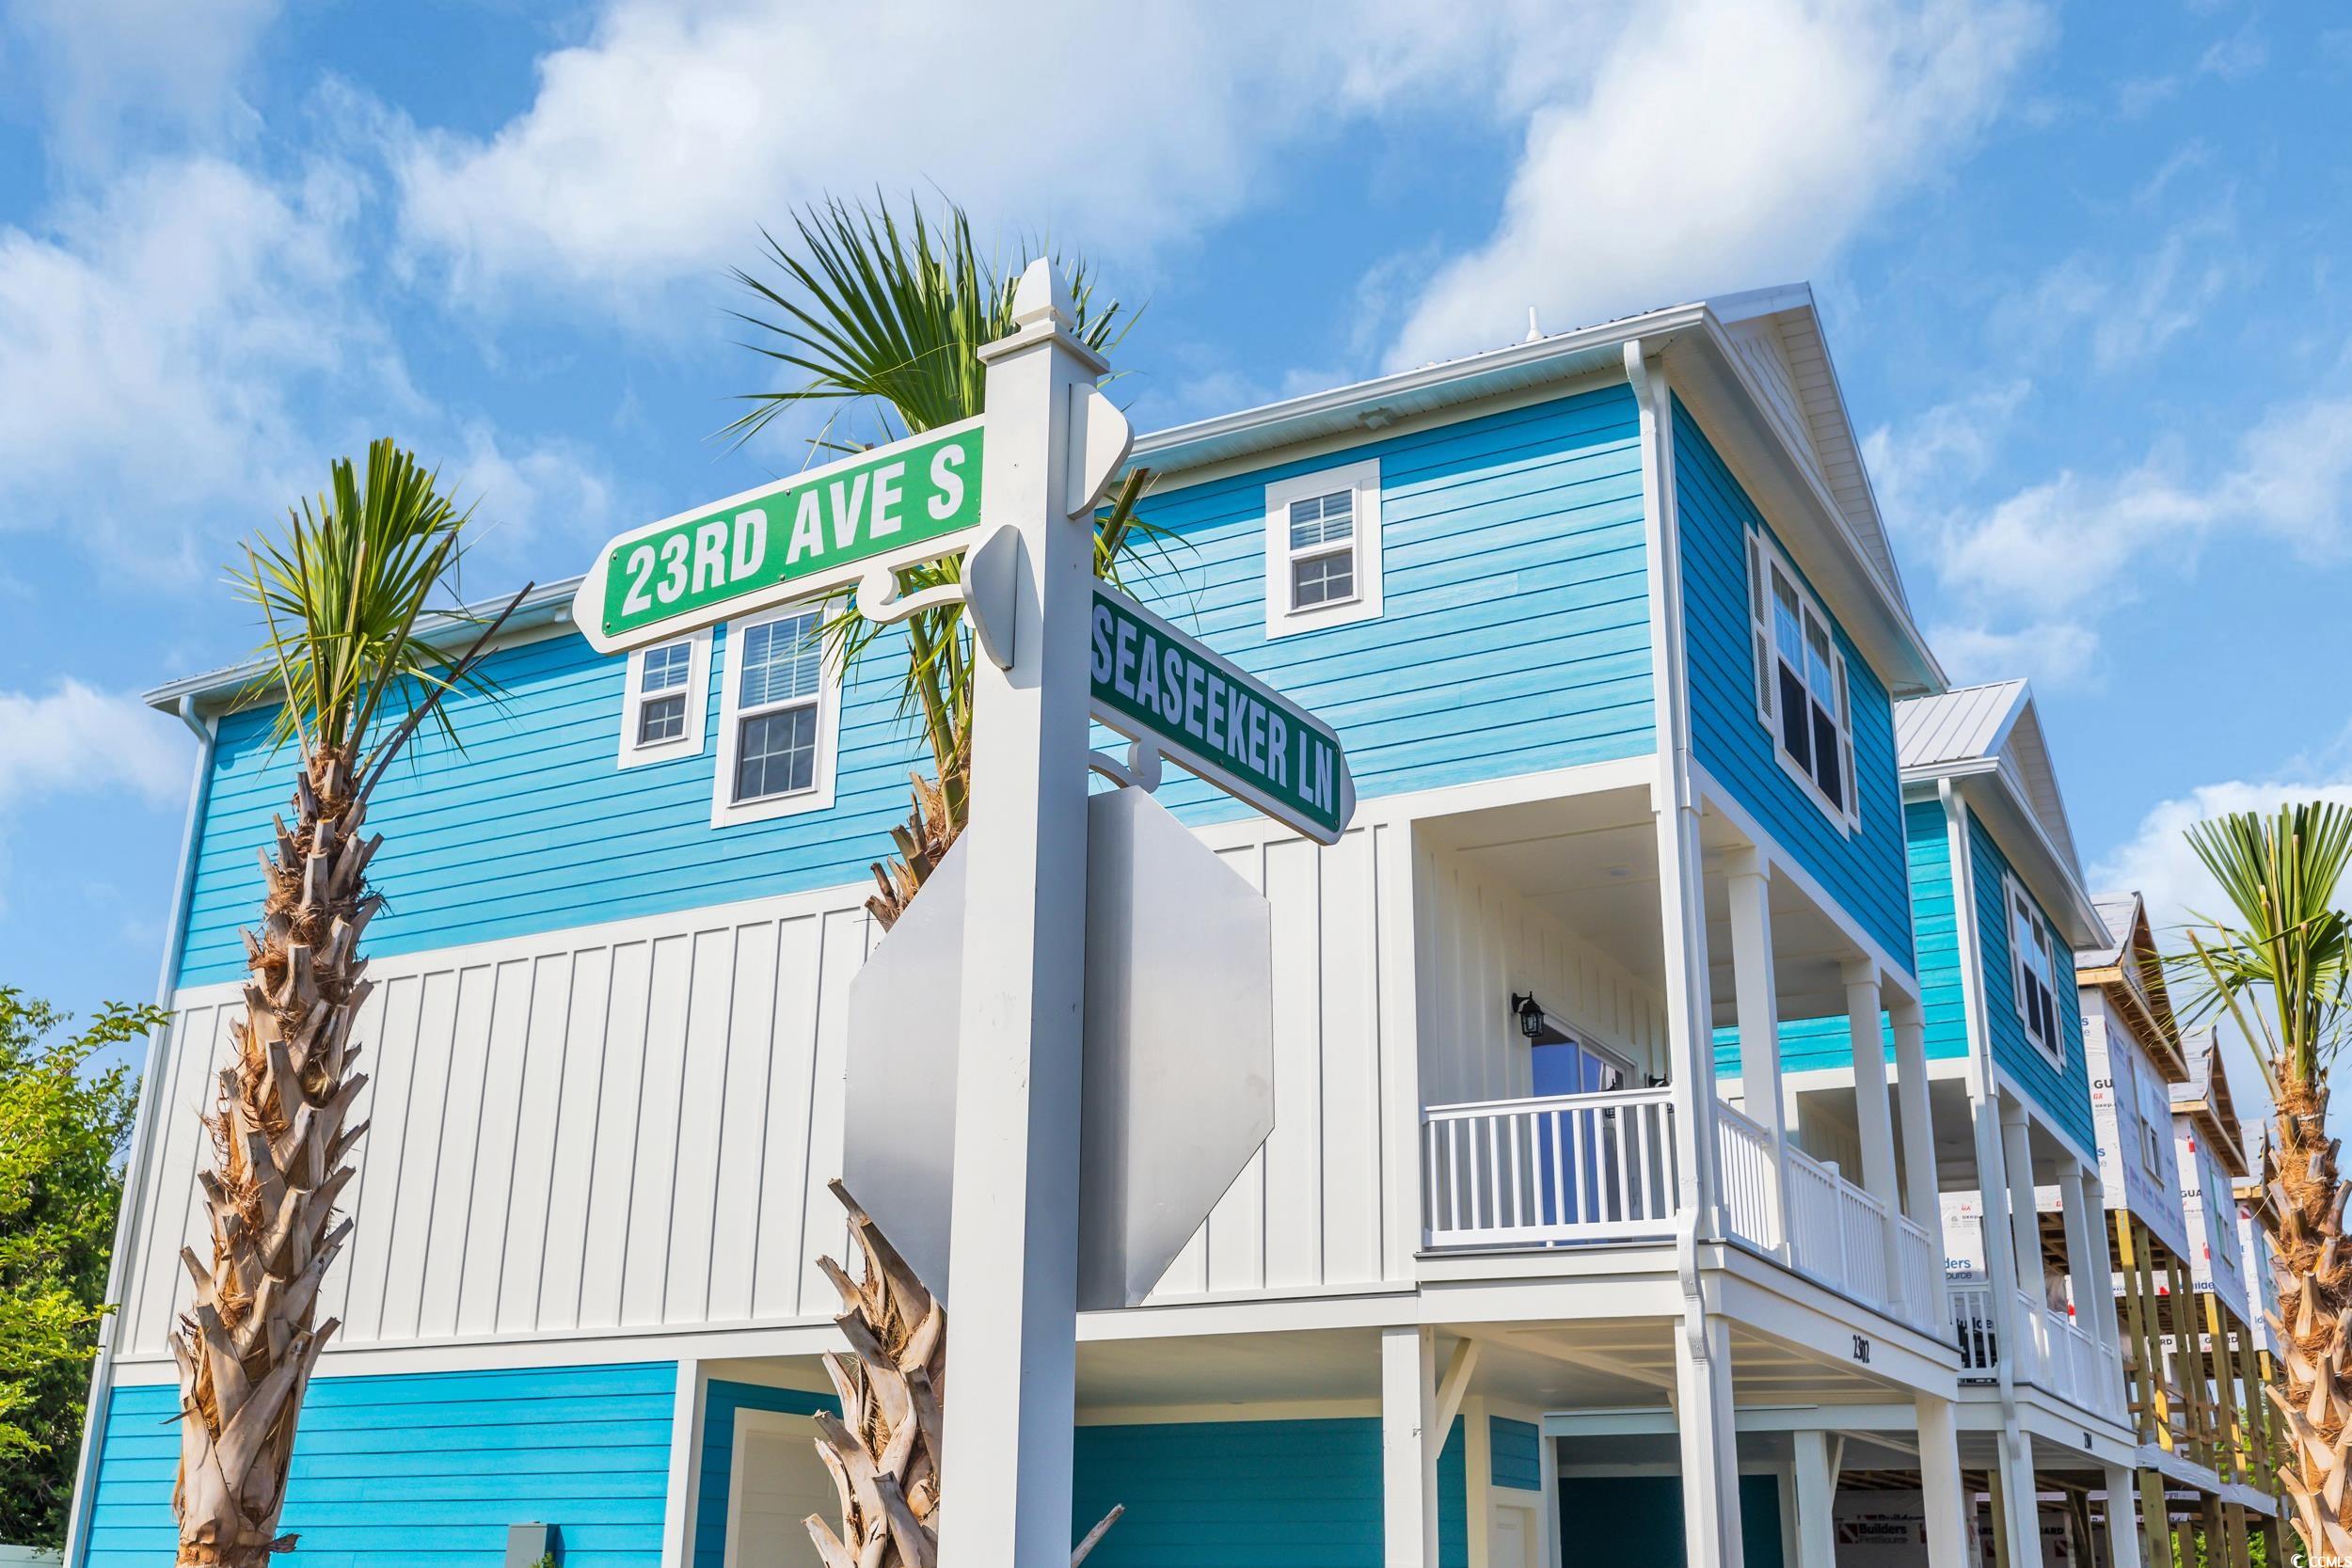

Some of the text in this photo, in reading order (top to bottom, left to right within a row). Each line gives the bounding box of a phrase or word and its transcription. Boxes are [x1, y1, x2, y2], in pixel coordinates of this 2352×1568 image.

[622, 444, 965, 617] 23RD AVE S
[1091, 604, 1332, 815] SEASEEKER LN
[1852, 1334, 1870, 1364] 2302
[1859, 1523, 1907, 1535] Builders
